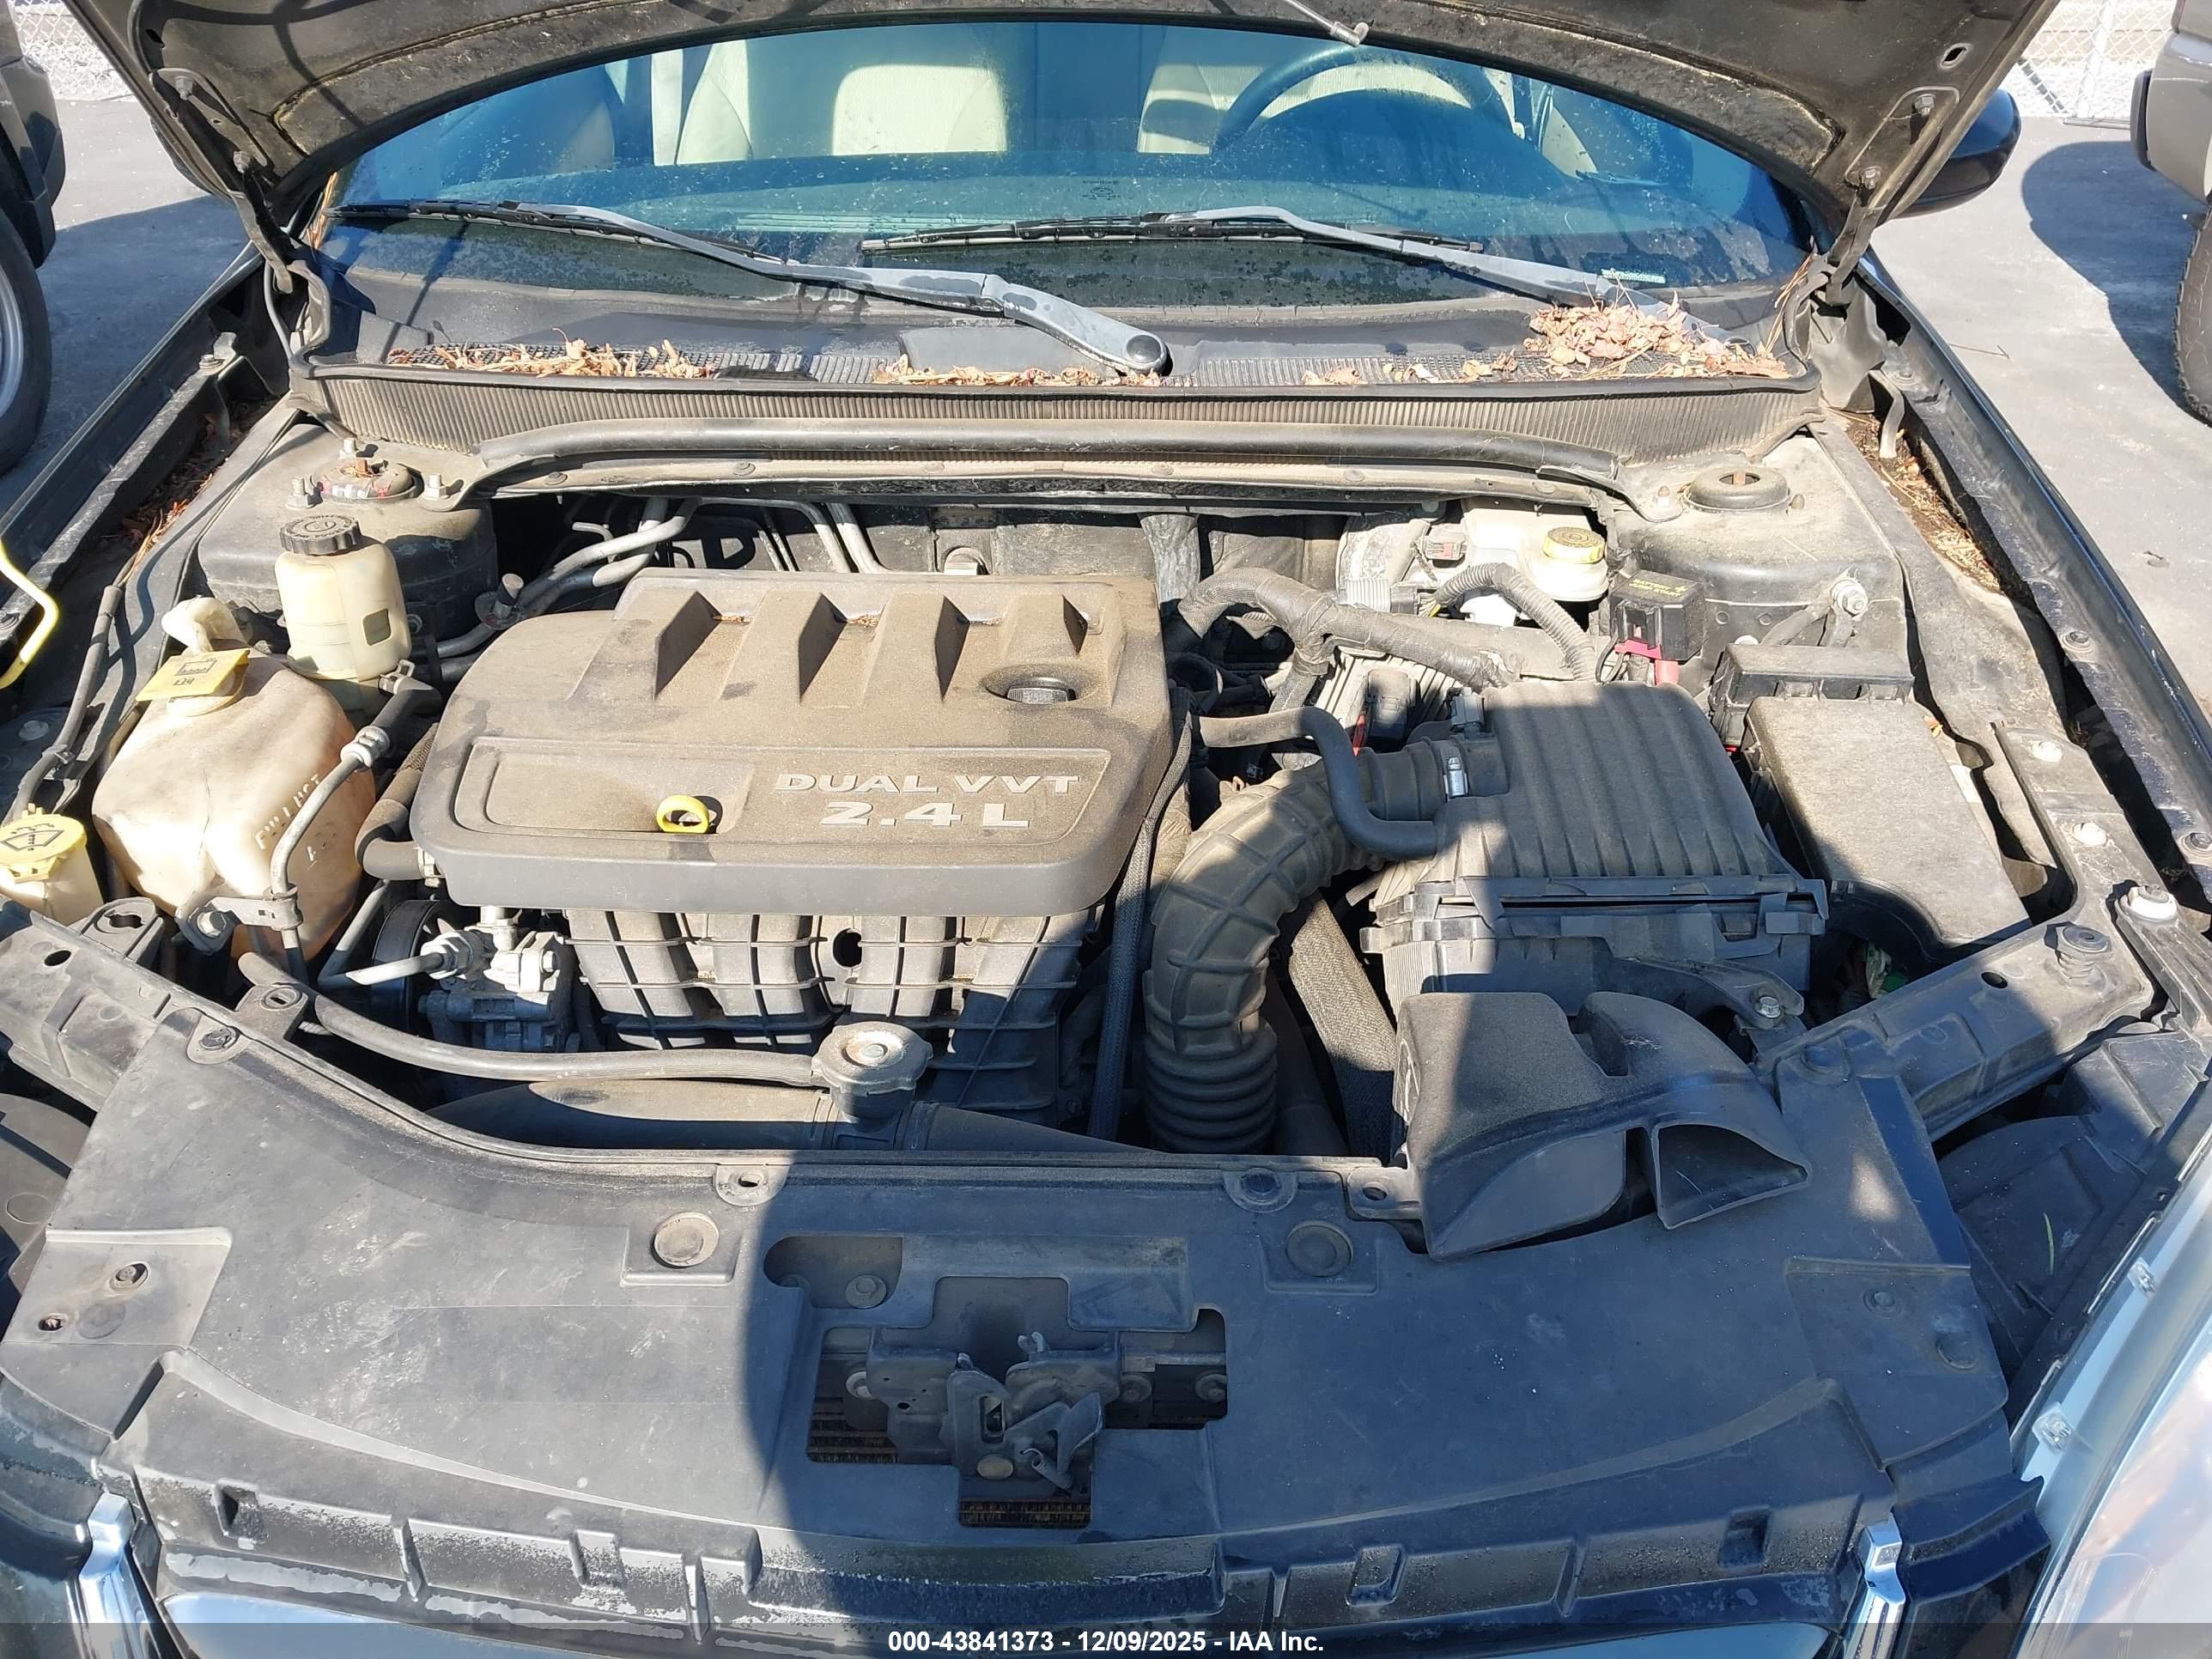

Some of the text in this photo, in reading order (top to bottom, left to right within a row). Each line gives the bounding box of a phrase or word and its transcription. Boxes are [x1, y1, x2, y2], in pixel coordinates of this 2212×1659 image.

[775, 774, 1081, 793] DUAL VVT
[822, 801, 1030, 828] 2.4 L
